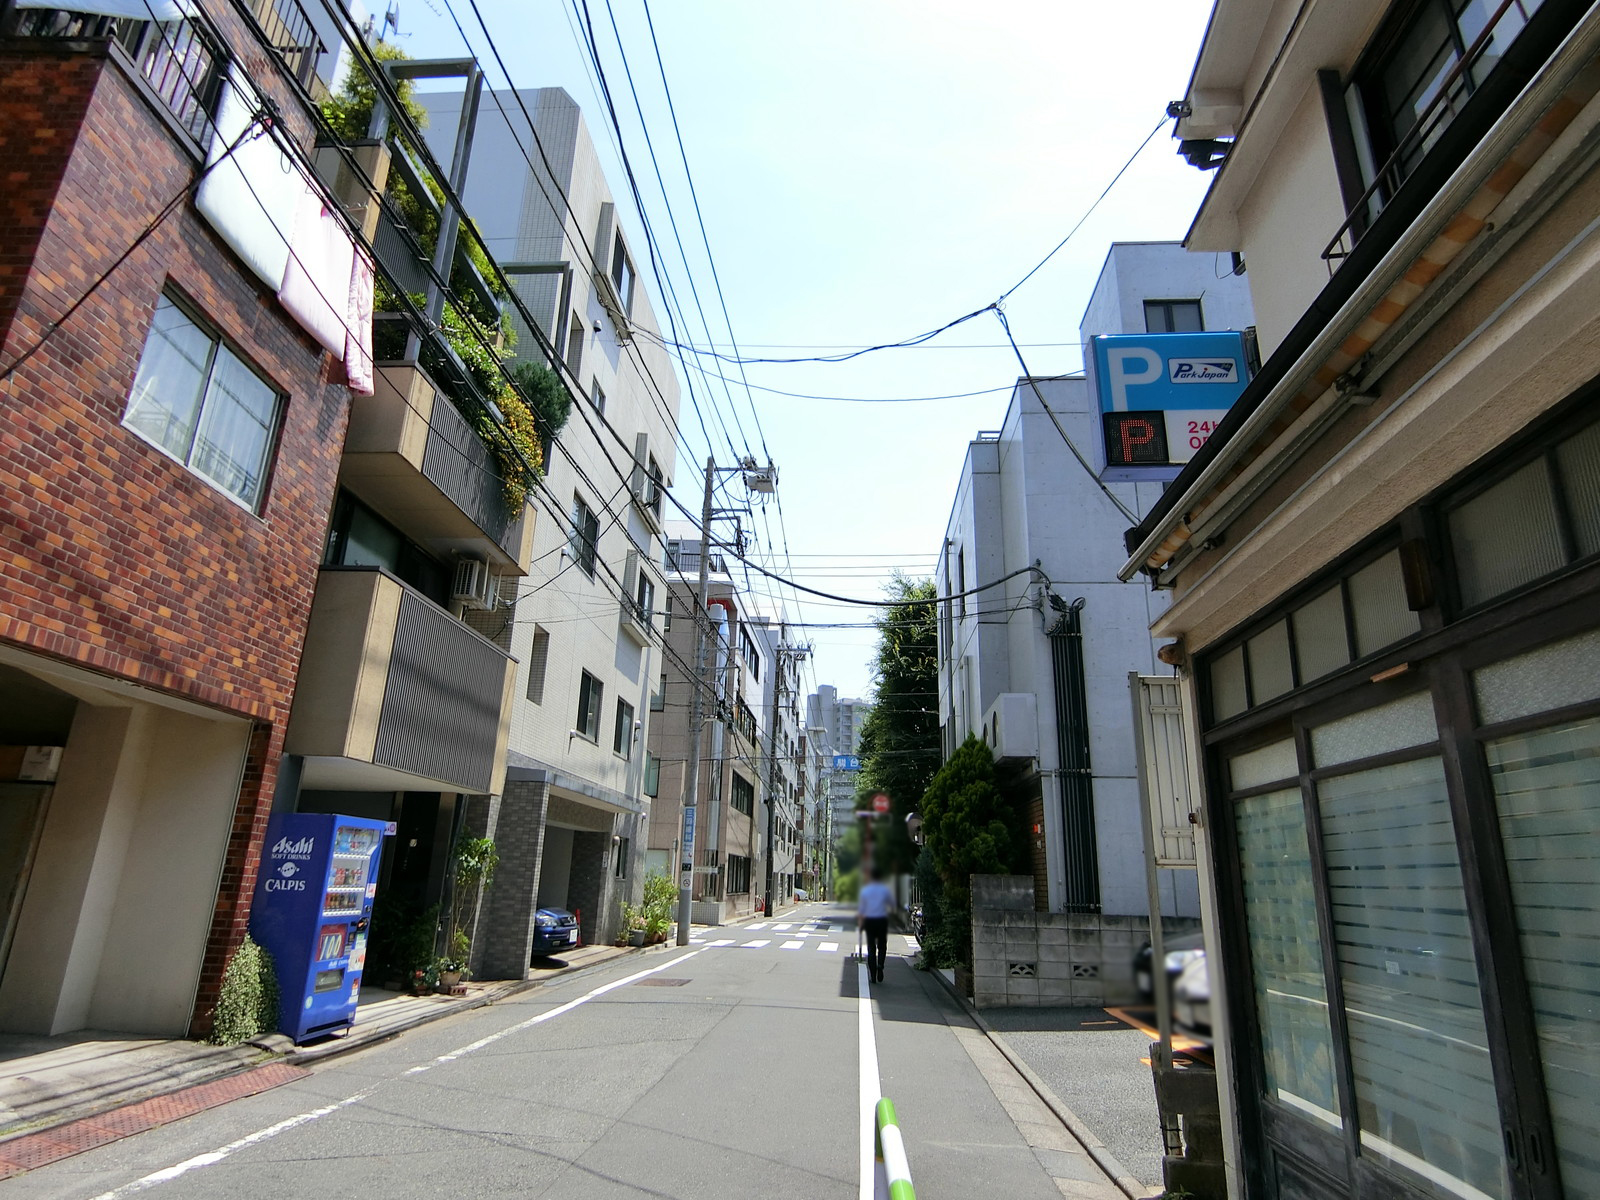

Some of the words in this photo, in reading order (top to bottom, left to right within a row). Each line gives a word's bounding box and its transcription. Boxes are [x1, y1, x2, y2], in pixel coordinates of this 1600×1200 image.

[1107, 347, 1163, 412] P
[1120, 420, 1155, 462] P
[272, 836, 315, 854] Asahi
[265, 879, 306, 892] CALPIS
